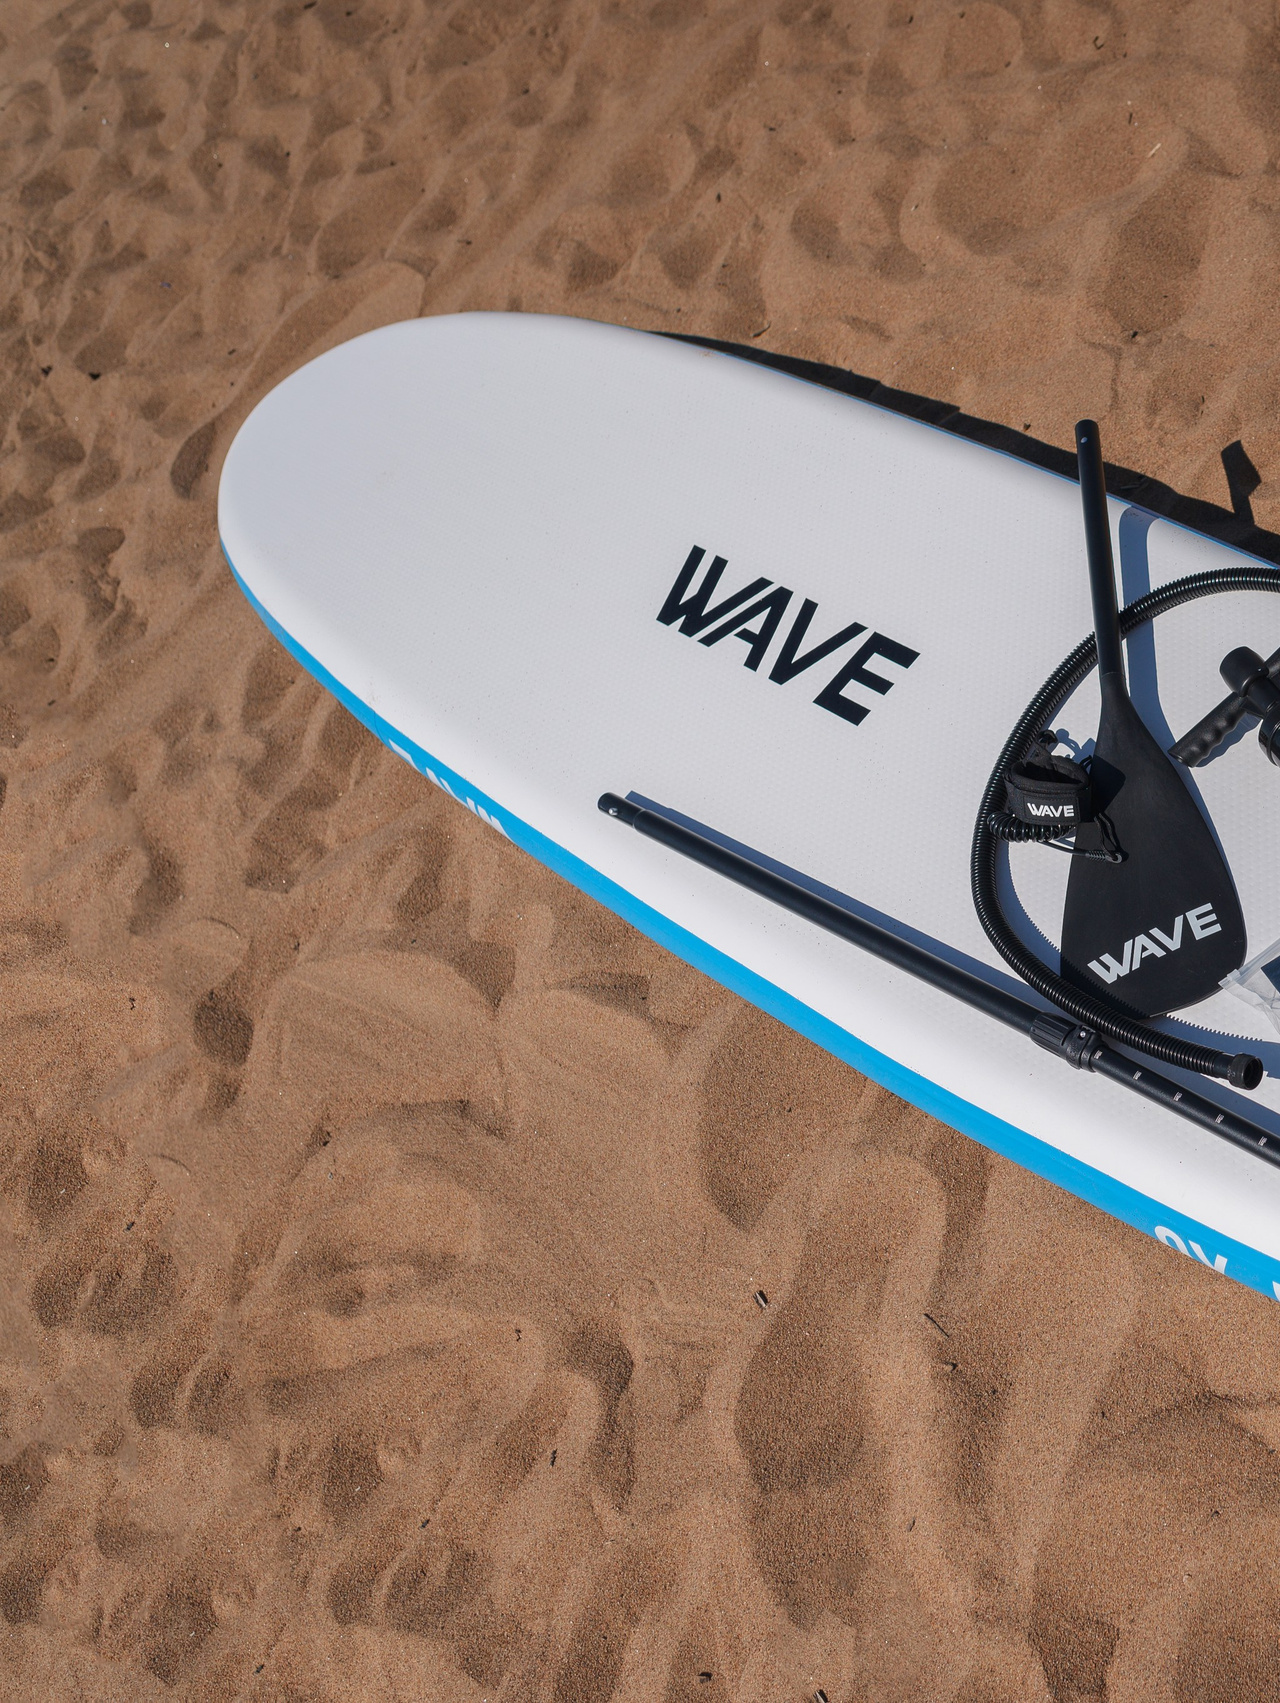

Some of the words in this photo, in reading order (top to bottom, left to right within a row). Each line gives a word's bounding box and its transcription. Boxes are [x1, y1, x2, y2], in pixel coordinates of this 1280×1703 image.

[656, 544, 921, 726] WAVE
[1027, 803, 1074, 817] WAVE
[1087, 903, 1222, 984] WAVE
